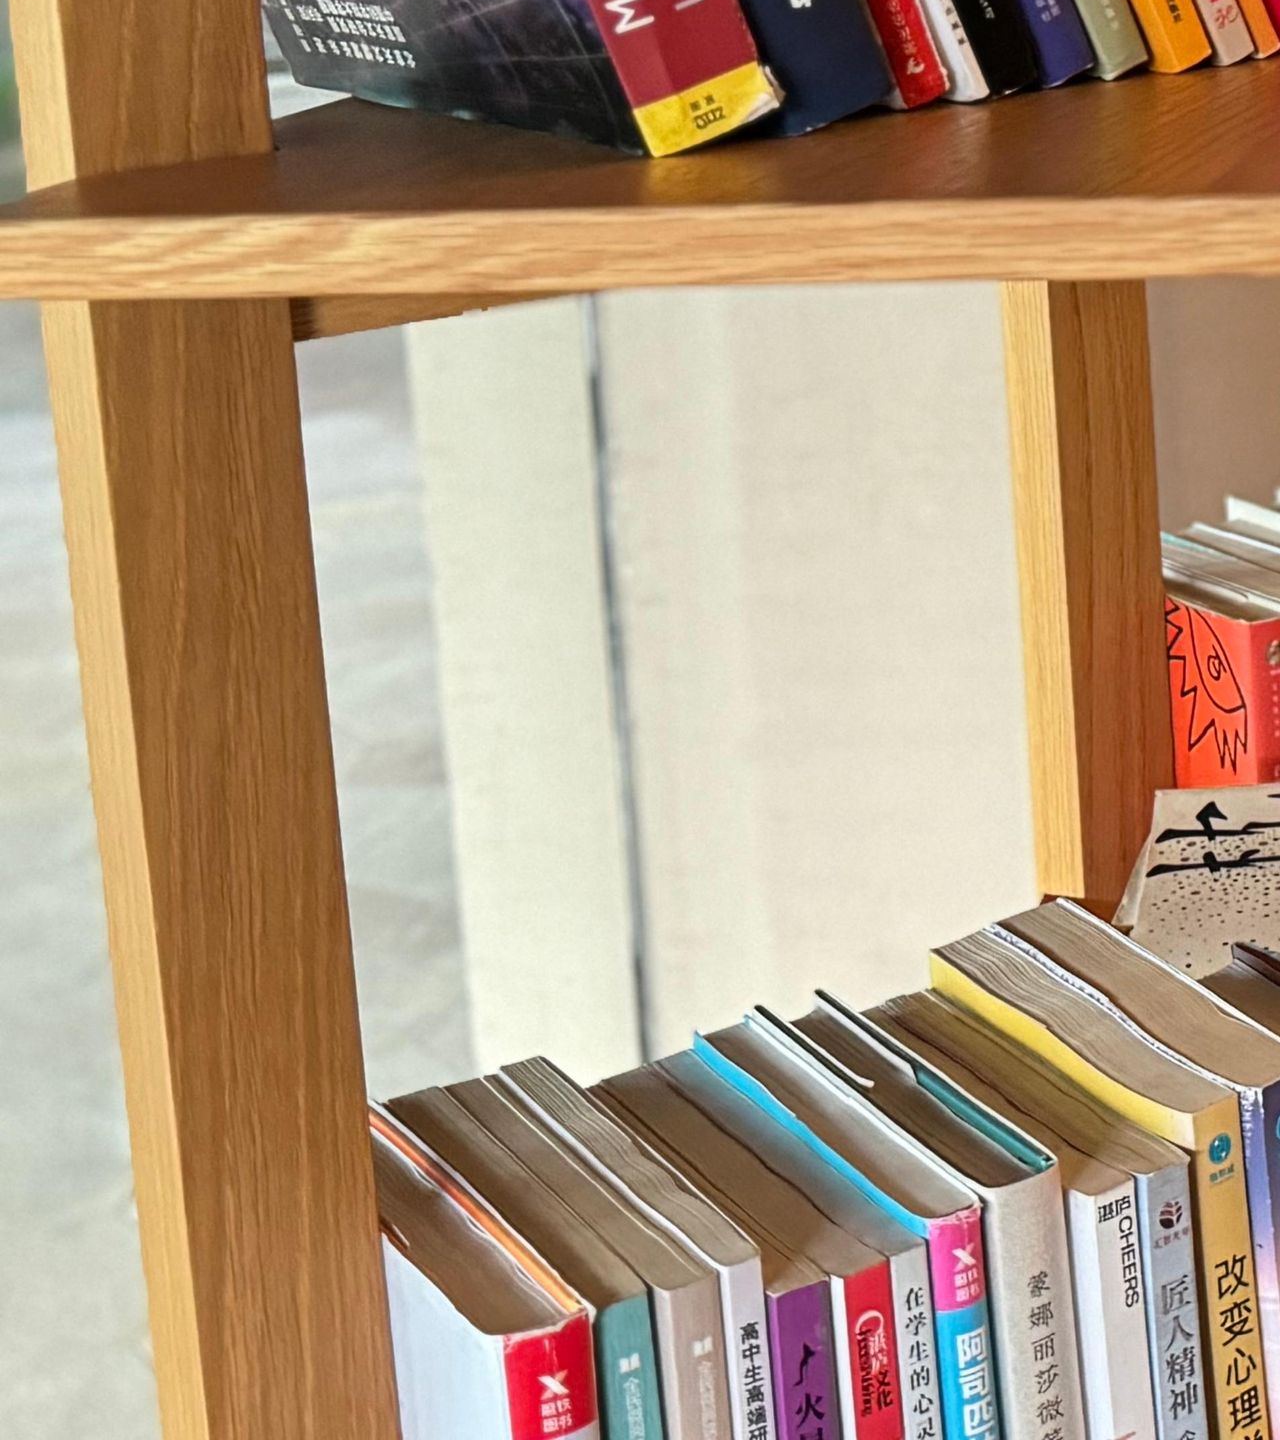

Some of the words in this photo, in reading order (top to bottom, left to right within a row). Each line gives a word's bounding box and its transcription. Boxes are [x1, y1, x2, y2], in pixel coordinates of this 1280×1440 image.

[1118, 1216, 1141, 1308] CHEERS
[956, 1327, 996, 1440] 阿司匹
[1161, 1274, 1198, 1420] 匠人精神
[542, 1417, 573, 1434] 图书
